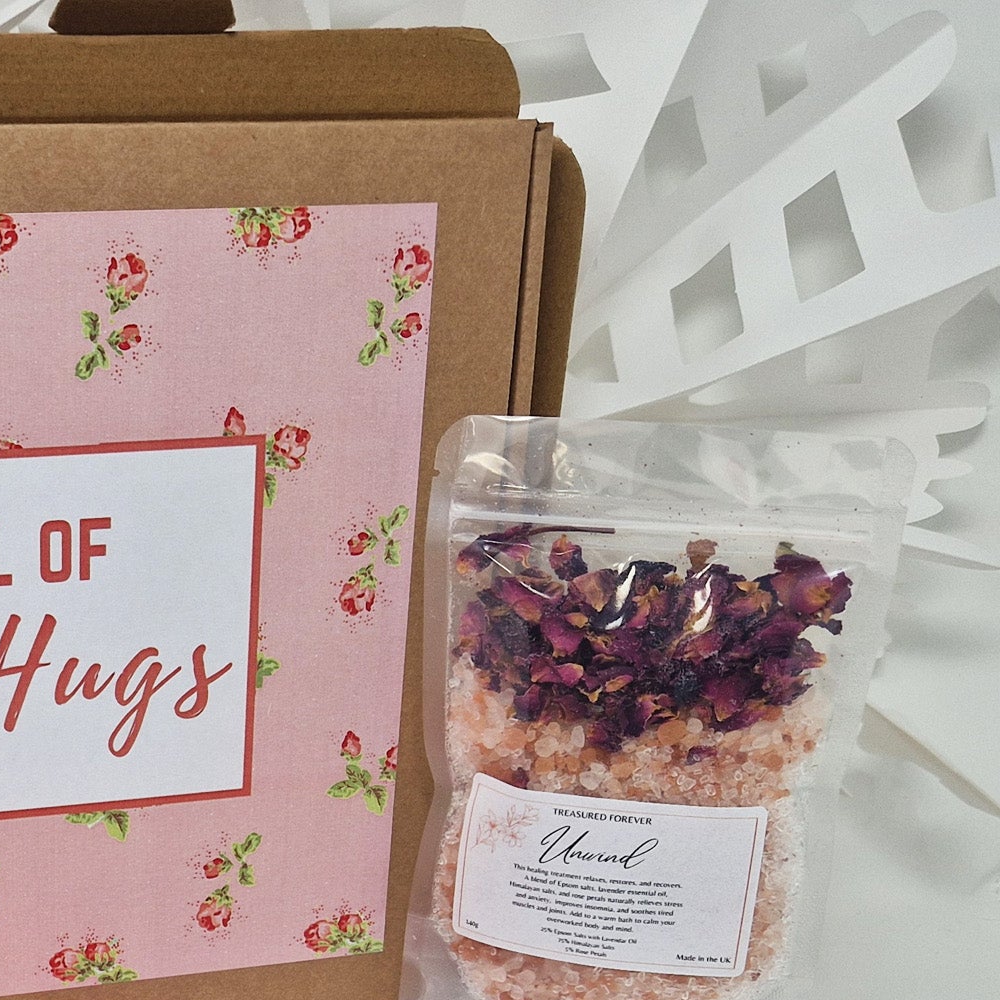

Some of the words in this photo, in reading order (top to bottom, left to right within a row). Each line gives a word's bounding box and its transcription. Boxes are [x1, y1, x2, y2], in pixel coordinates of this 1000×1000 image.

[38, 516, 113, 582] OF
[553, 808, 607, 821] TREASURED
[609, 814, 652, 825] FOREVER
[538, 825, 659, 869] Unwind
